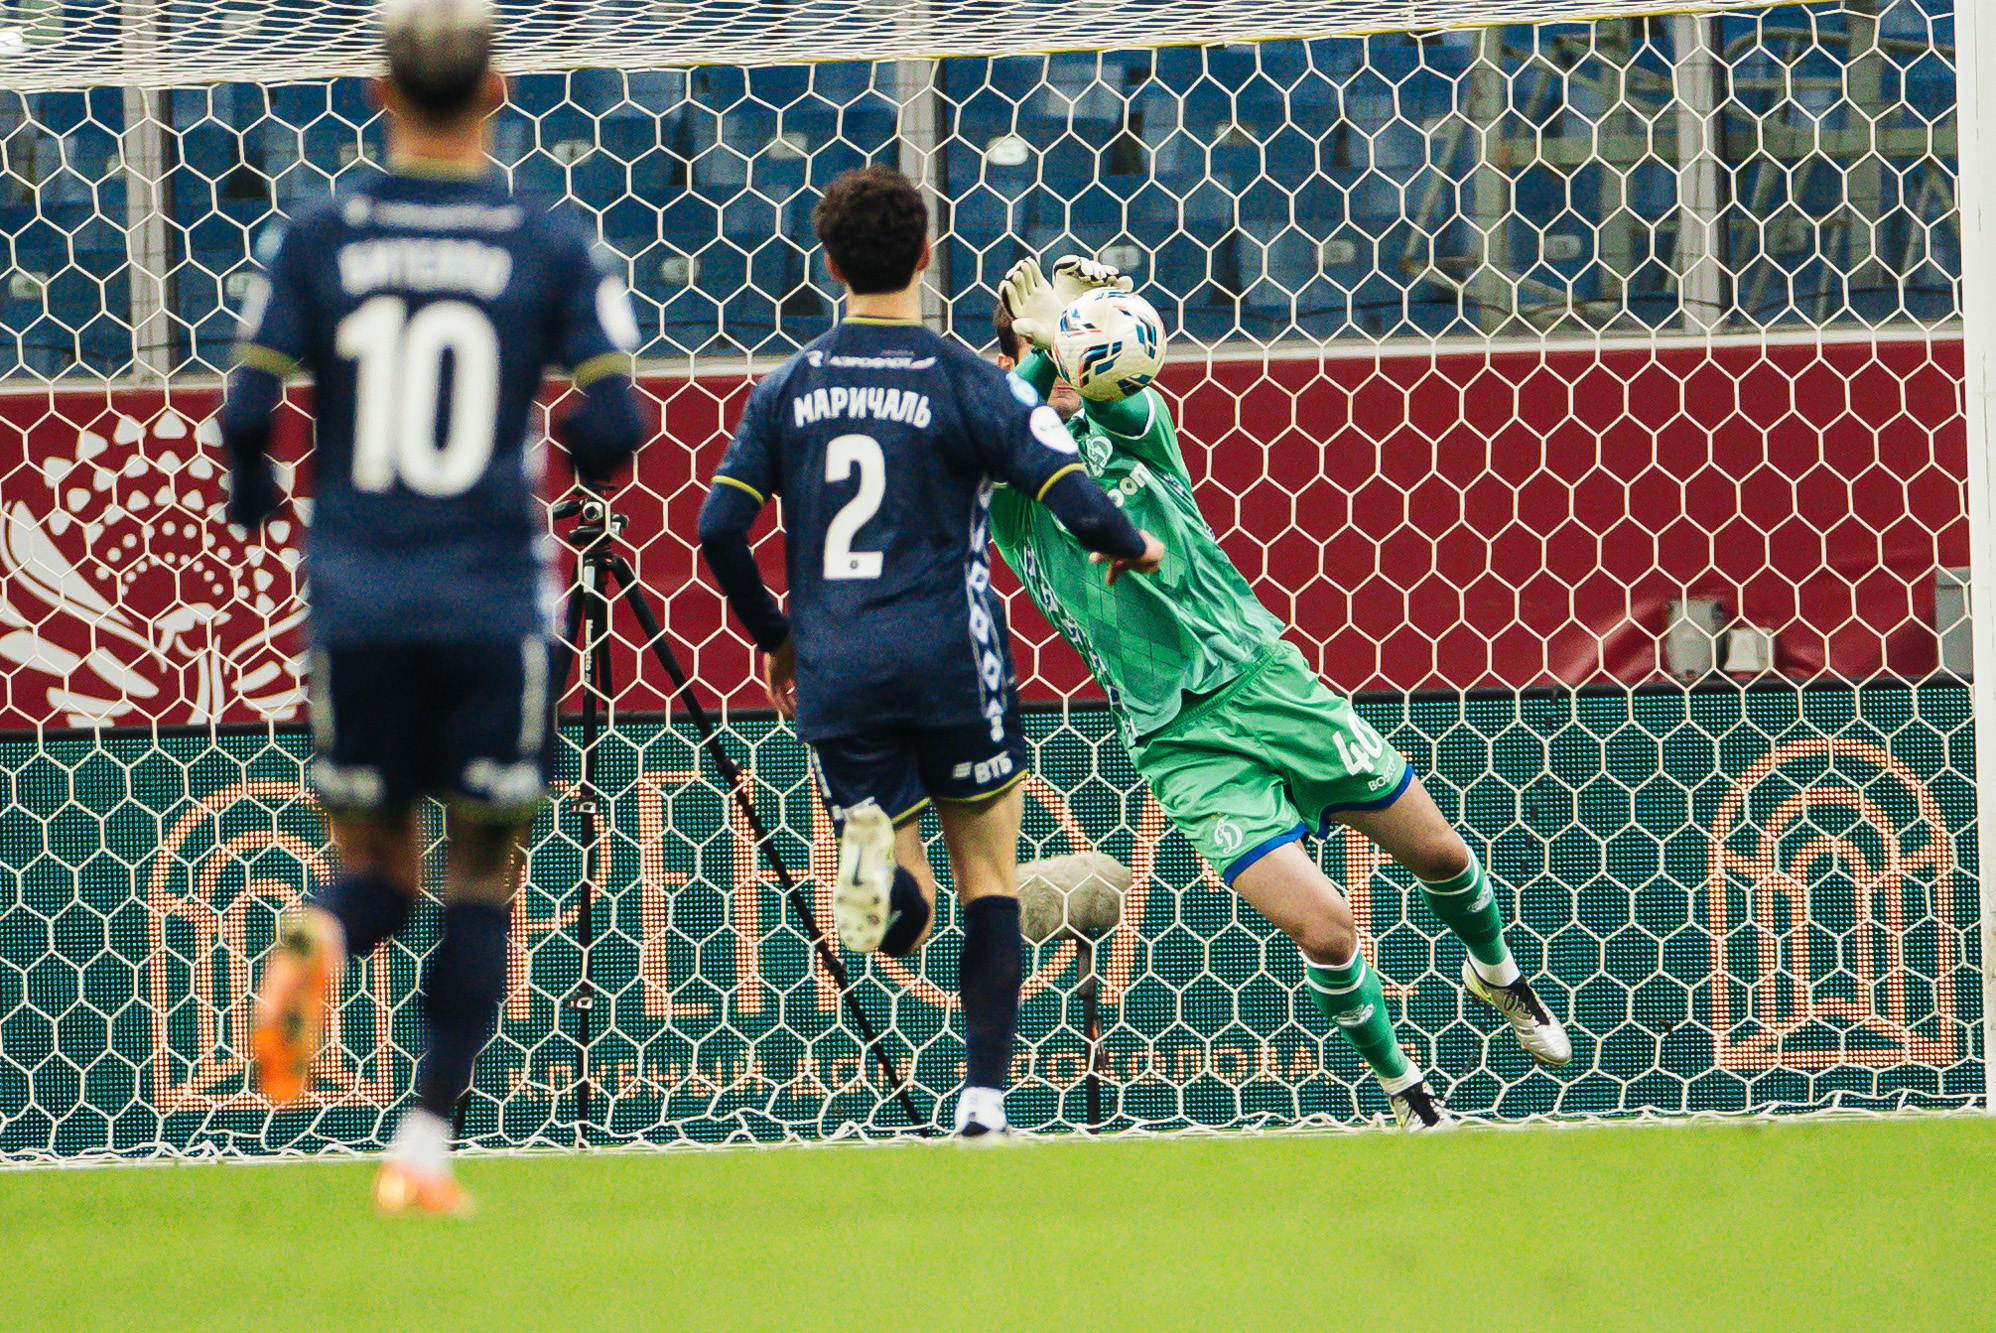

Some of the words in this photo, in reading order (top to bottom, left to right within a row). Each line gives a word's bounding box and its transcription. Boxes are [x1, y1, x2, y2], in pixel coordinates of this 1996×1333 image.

[335, 294, 501, 497] 10
[793, 386, 932, 428] МАРИЧАЛЬ
[823, 434, 886, 580] 2
[1332, 712, 1384, 776] 40
